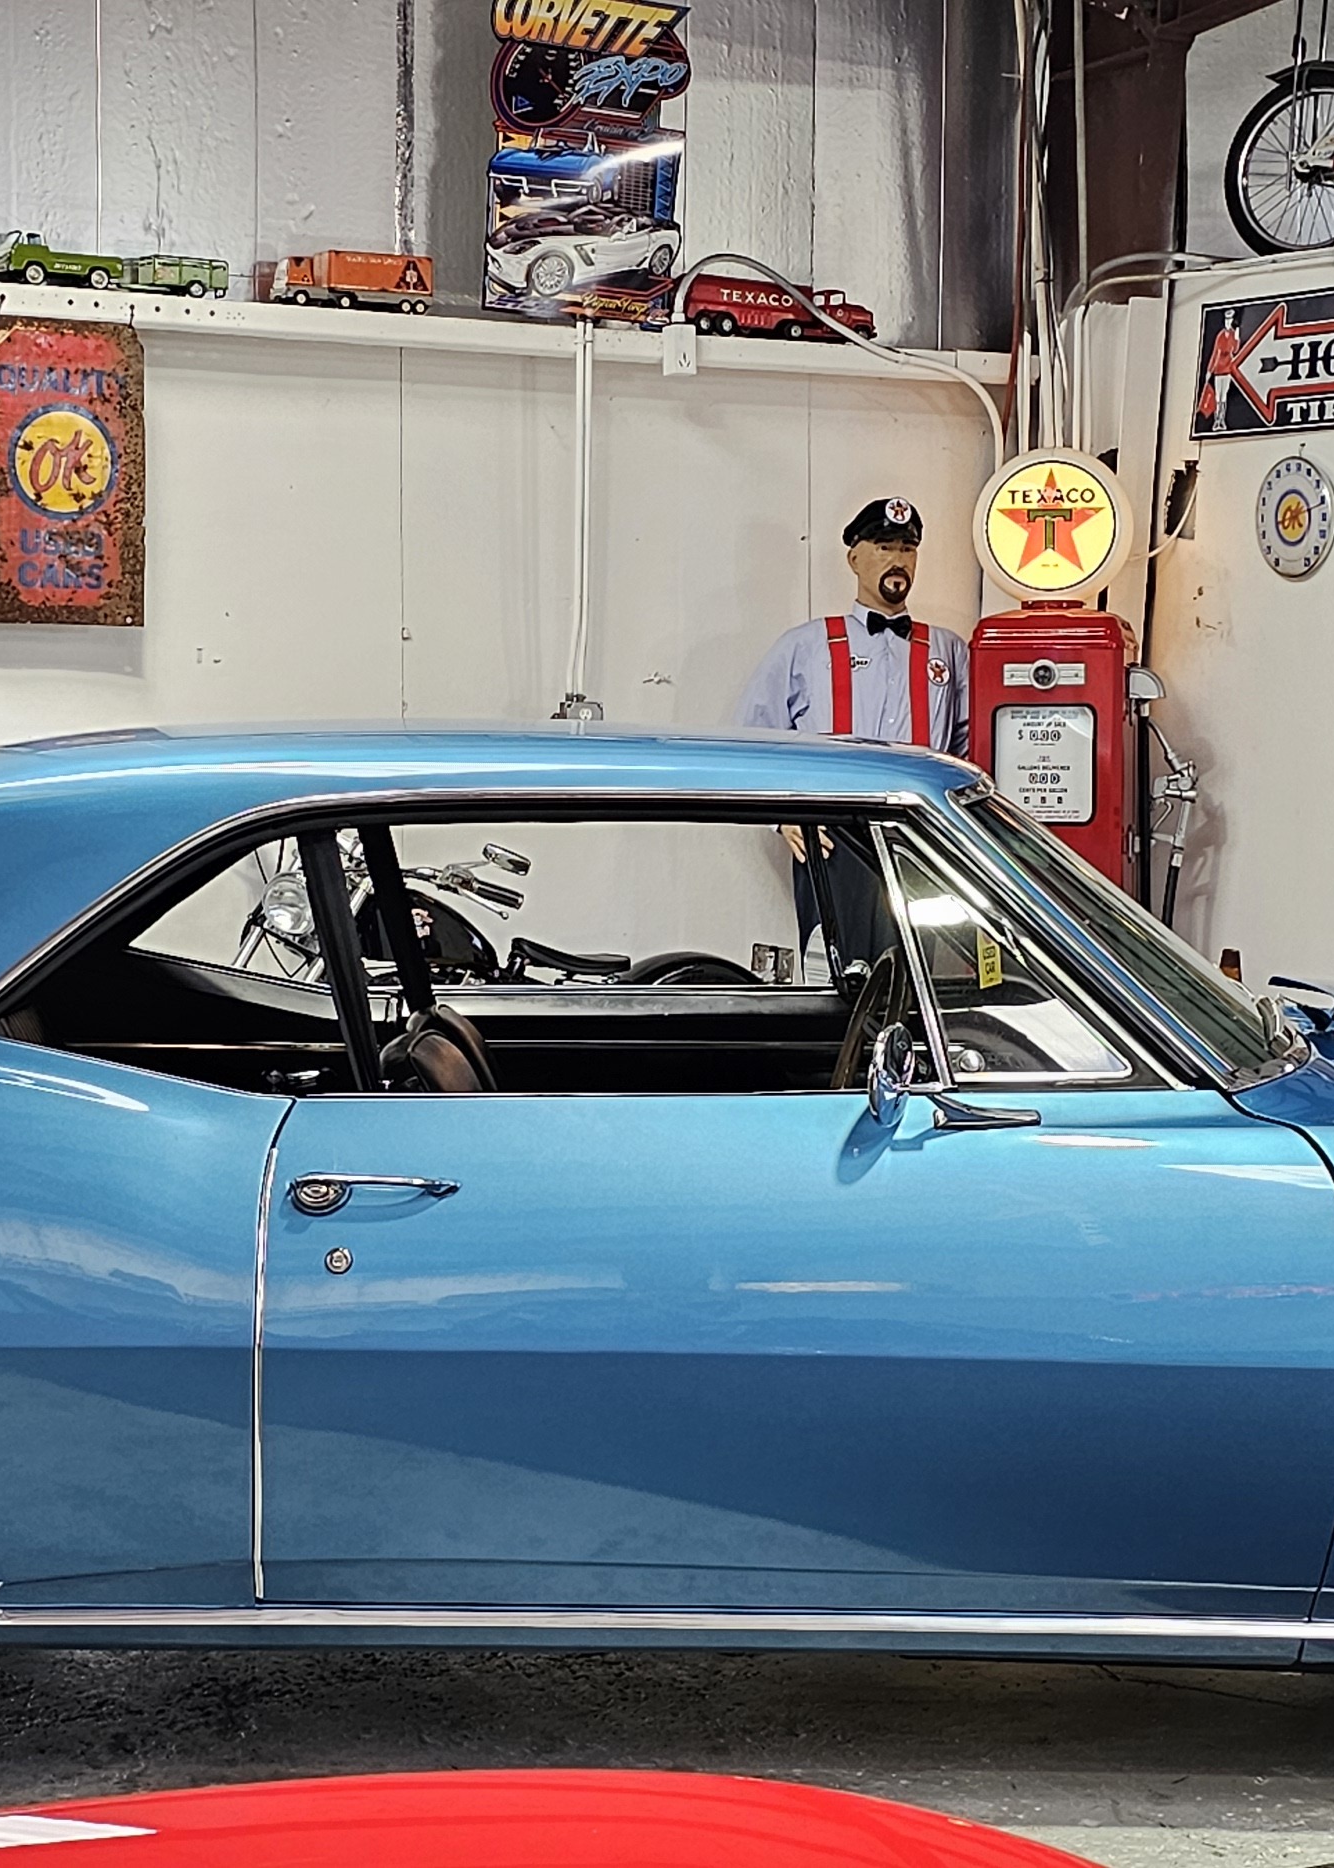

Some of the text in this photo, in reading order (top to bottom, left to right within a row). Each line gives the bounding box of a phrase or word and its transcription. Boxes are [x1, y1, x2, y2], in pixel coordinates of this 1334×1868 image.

[495, 0, 677, 57] CORVETTE
[720, 288, 794, 307] TEXACO
[1007, 487, 1096, 504] TEXACO
[20, 528, 104, 557] USED
[18, 559, 105, 590] CARS
